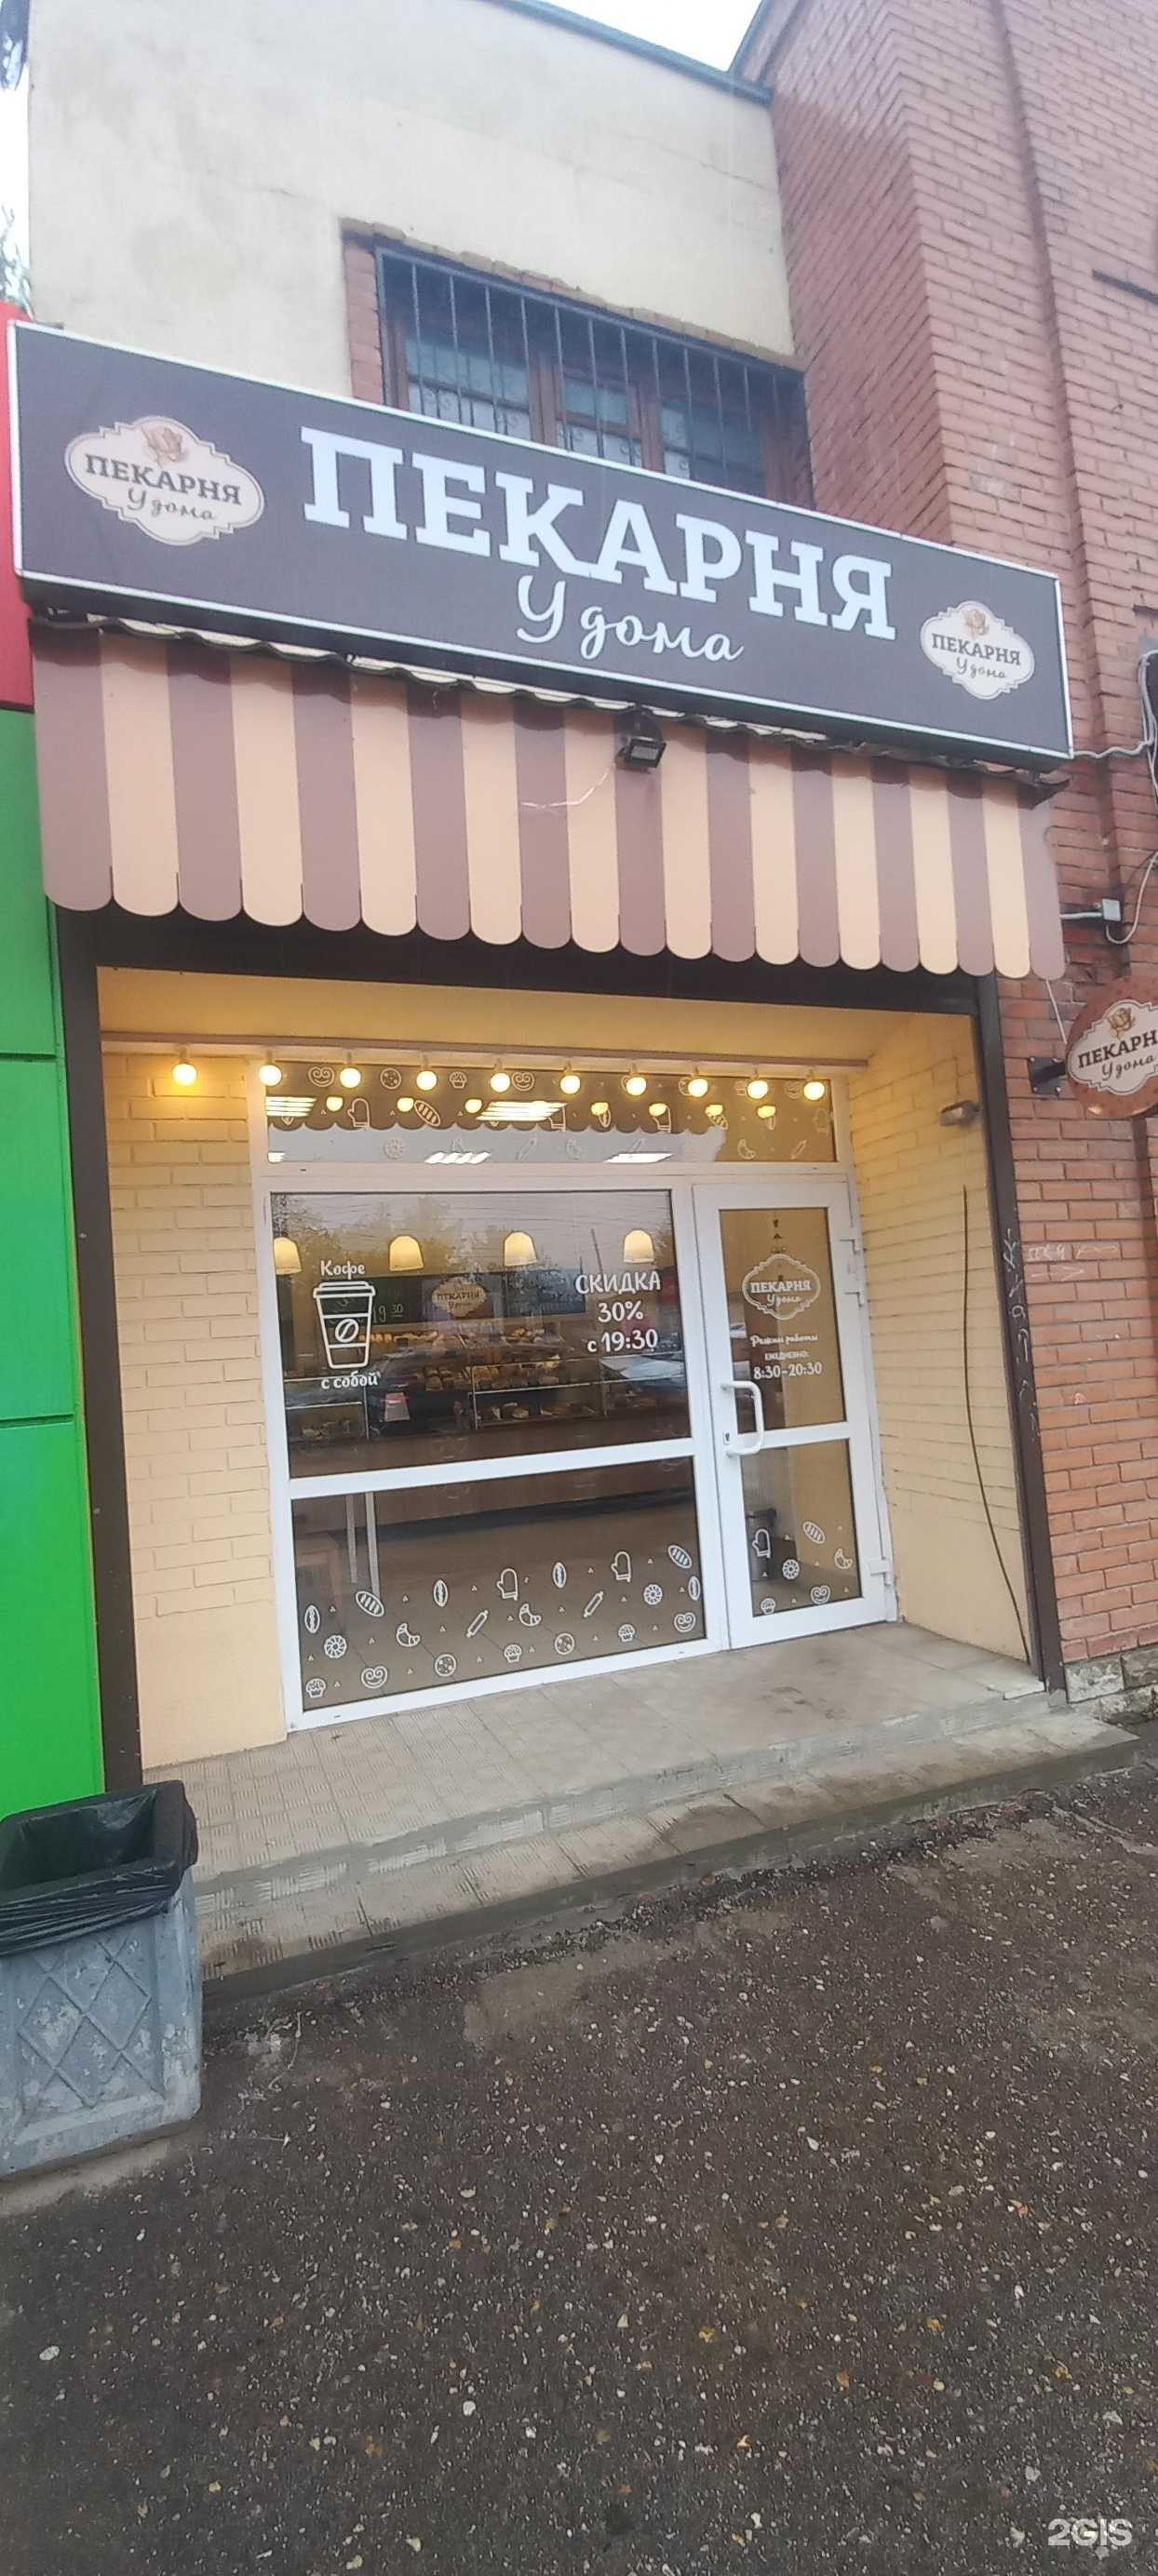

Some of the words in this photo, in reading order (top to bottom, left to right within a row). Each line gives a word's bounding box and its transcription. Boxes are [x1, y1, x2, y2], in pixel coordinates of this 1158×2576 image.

[86, 453, 242, 505] ПЕКАРНЯ
[128, 487, 147, 511] У
[152, 499, 215, 519] дома
[300, 425, 896, 641] ПЕКАРНЯ
[516, 574, 567, 644] У
[579, 605, 745, 662] дома
[931, 633, 1021, 665] ПЕКАРНЯ
[956, 656, 968, 675] У
[970, 664, 1006, 678] дома
[1101, 1062, 1113, 1081] У
[1115, 1055, 1154, 1080] дома
[320, 1260, 366, 1280] Кофе
[575, 1271, 661, 1295] СКИДКА
[750, 1280, 812, 1294] ПЕКАРНЯ
[598, 1300, 644, 1322] 30%
[766, 1294, 776, 1307] У
[586, 1340, 598, 1352] с
[600, 1329, 658, 1352] 19:30
[320, 1377, 330, 1389] с
[333, 1370, 380, 1389] собой
